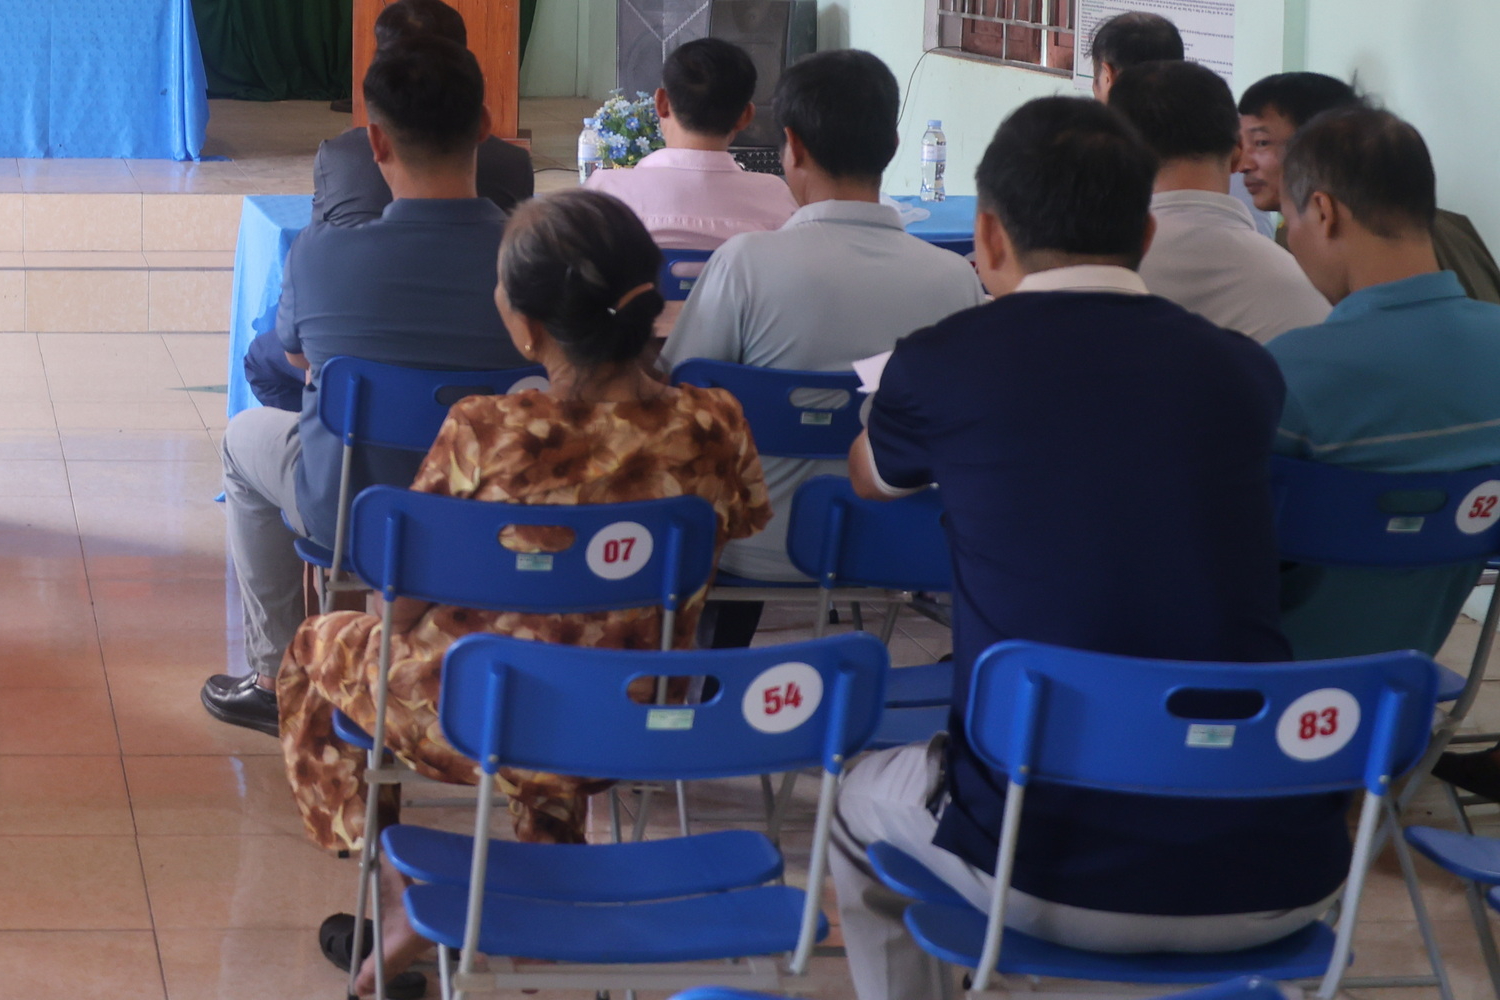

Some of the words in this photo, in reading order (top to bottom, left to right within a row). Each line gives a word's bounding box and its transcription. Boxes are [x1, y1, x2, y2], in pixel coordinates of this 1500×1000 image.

[1468, 495, 1498, 518] 52
[602, 536, 637, 564] 07
[762, 682, 802, 716] 54
[1298, 706, 1339, 741] 83
